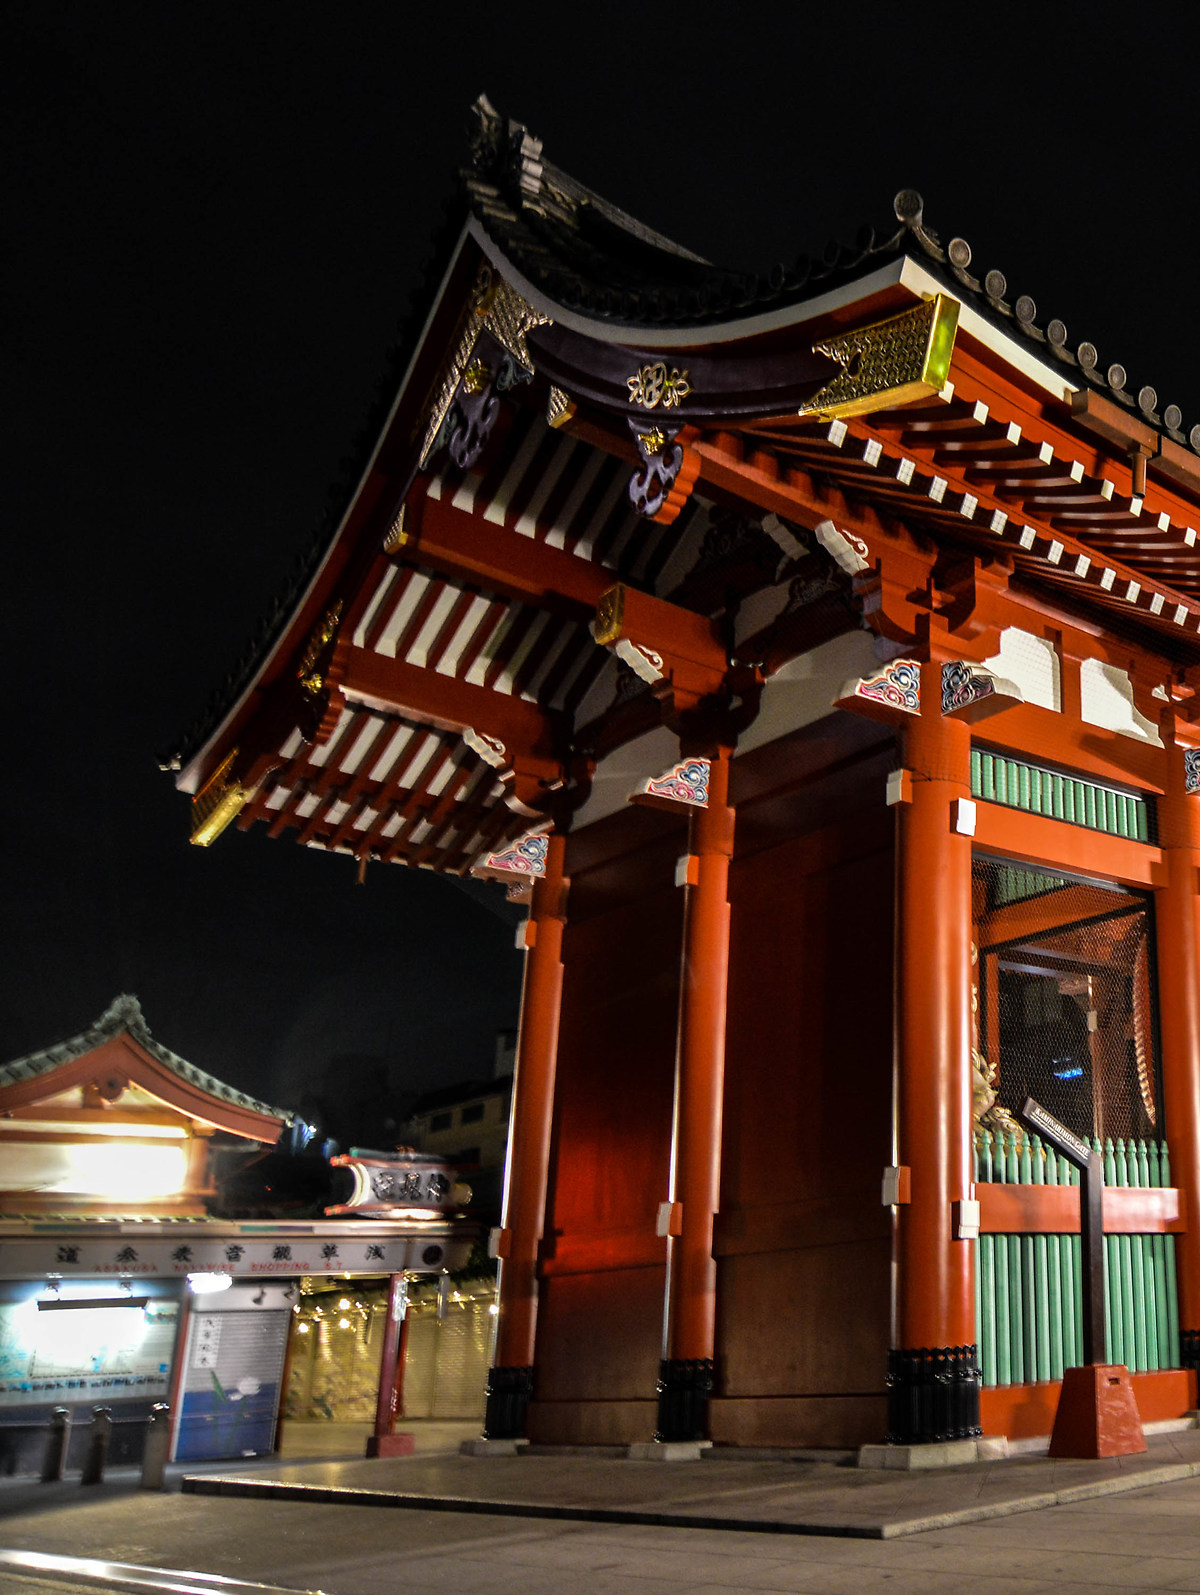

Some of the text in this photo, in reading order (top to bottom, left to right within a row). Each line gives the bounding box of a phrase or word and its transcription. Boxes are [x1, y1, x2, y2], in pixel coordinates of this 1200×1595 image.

[1034, 1107, 1075, 1144] KAMINARIMON
[1074, 1141, 1091, 1157] GATE
[94, 1264, 158, 1273] ASAKUSA
[250, 1261, 310, 1271] SHOPPING
